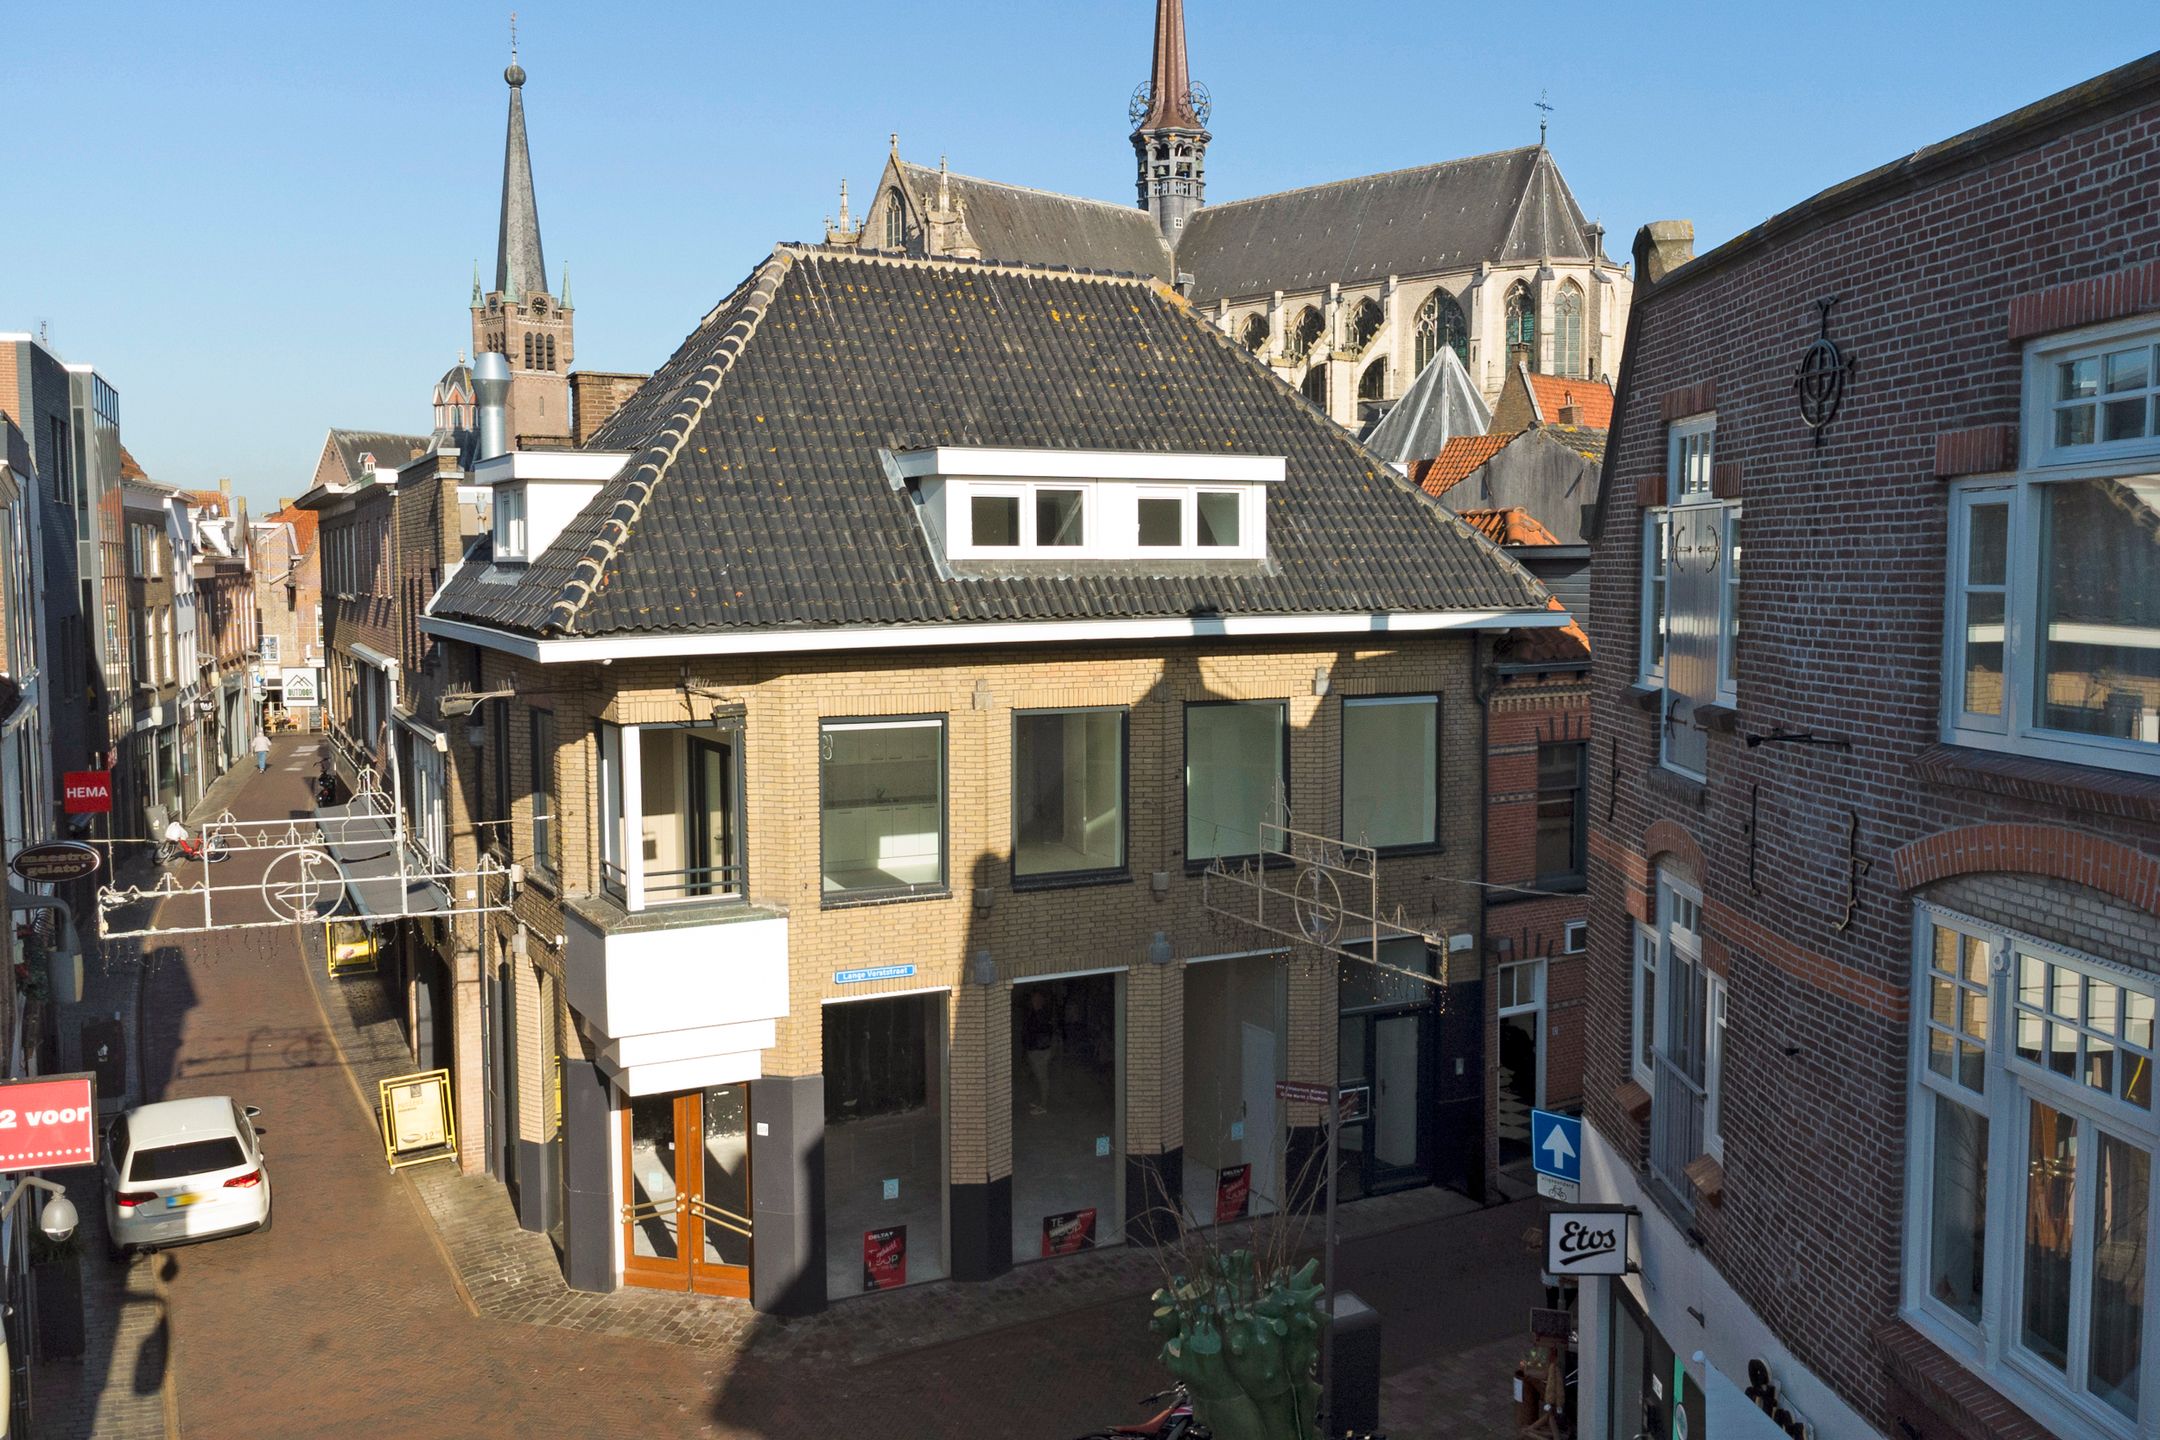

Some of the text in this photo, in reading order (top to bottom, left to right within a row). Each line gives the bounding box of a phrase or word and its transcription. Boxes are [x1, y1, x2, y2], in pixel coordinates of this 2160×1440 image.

[288, 689, 313, 697] OUTDOOR
[67, 786, 109, 799] HEMA
[21, 853, 92, 863] maestro
[27, 864, 81, 876] gelato
[843, 972, 866, 981] Lange
[0, 1106, 90, 1129] 2 voor
[1051, 1217, 1064, 1228] TE
[868, 1232, 890, 1241] DELTA
[1559, 1221, 1616, 1252] Etos
